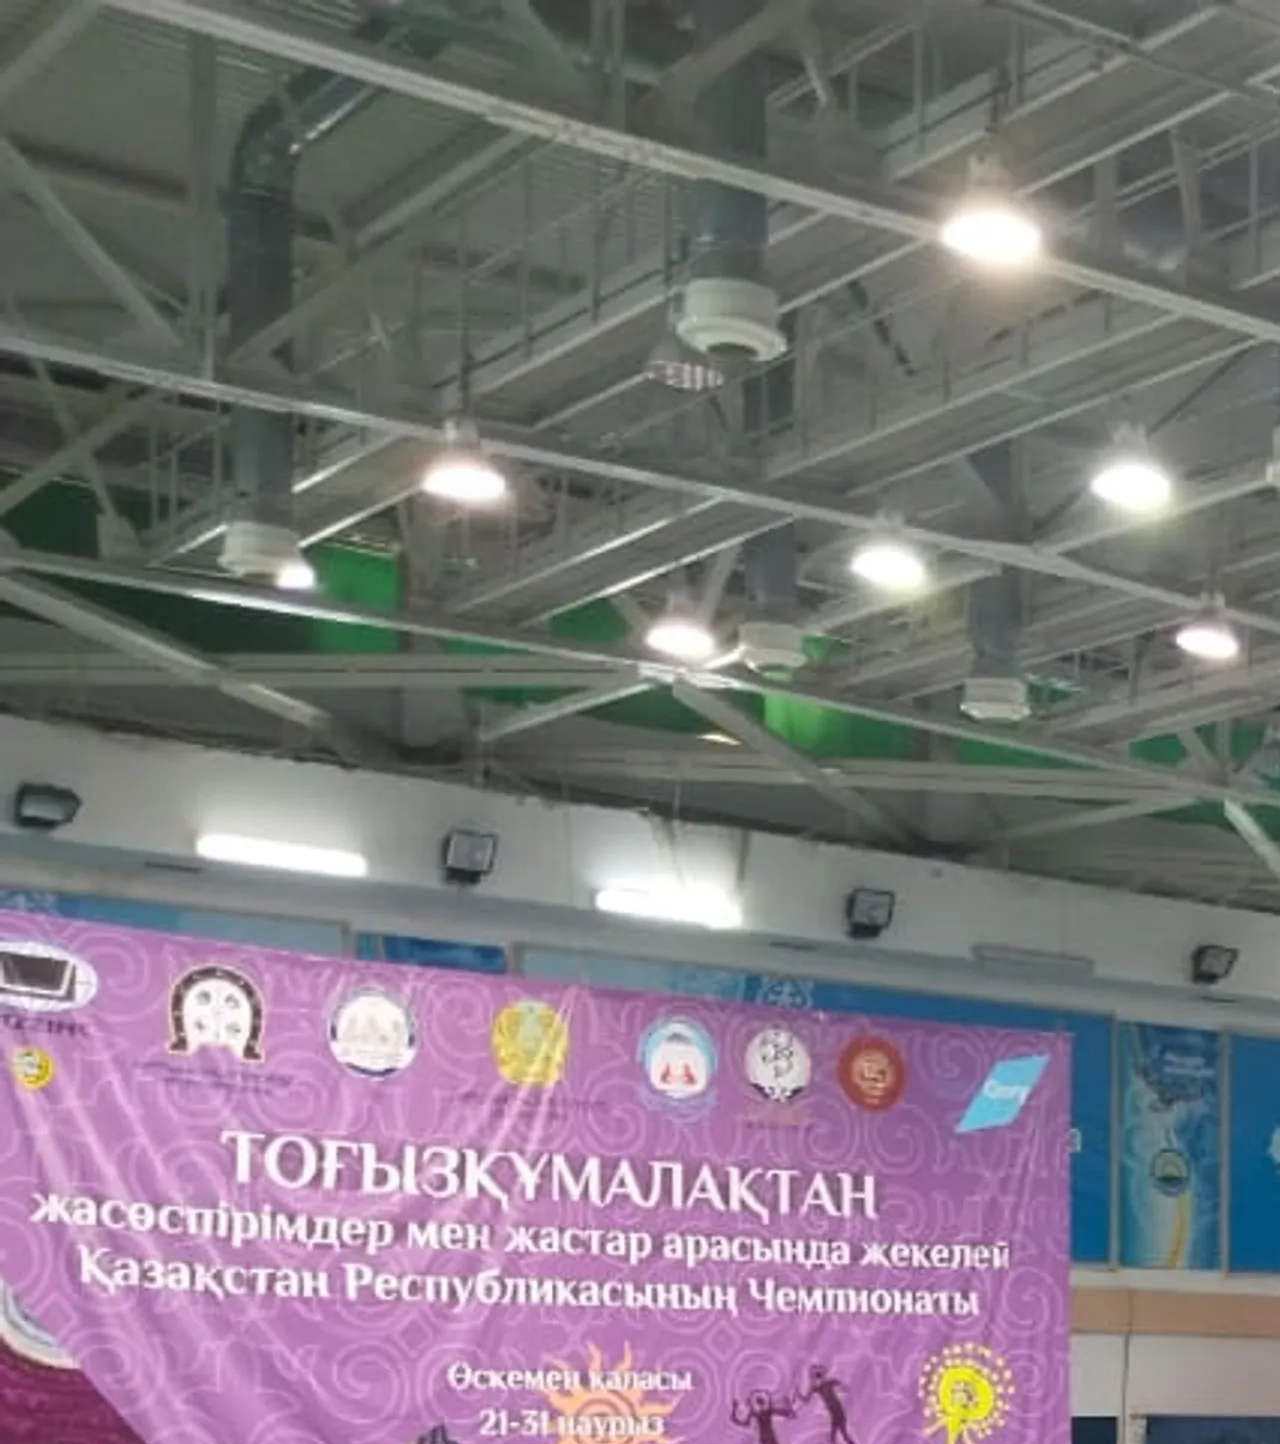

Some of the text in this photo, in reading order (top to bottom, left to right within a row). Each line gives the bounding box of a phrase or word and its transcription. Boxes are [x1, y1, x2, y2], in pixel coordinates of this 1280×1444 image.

[220, 1129, 881, 1226] ТОҒЫЗҚҰМАЛАҚТАН
[30, 1191, 1010, 1270] жасөспірімдер мен жастар арасында жекелей
[77, 1243, 980, 1318] Қазақстан Республикасының Чемпионаты
[446, 1361, 581, 1391] Өскемен
[479, 1409, 665, 1444] 21-31 наурыз
